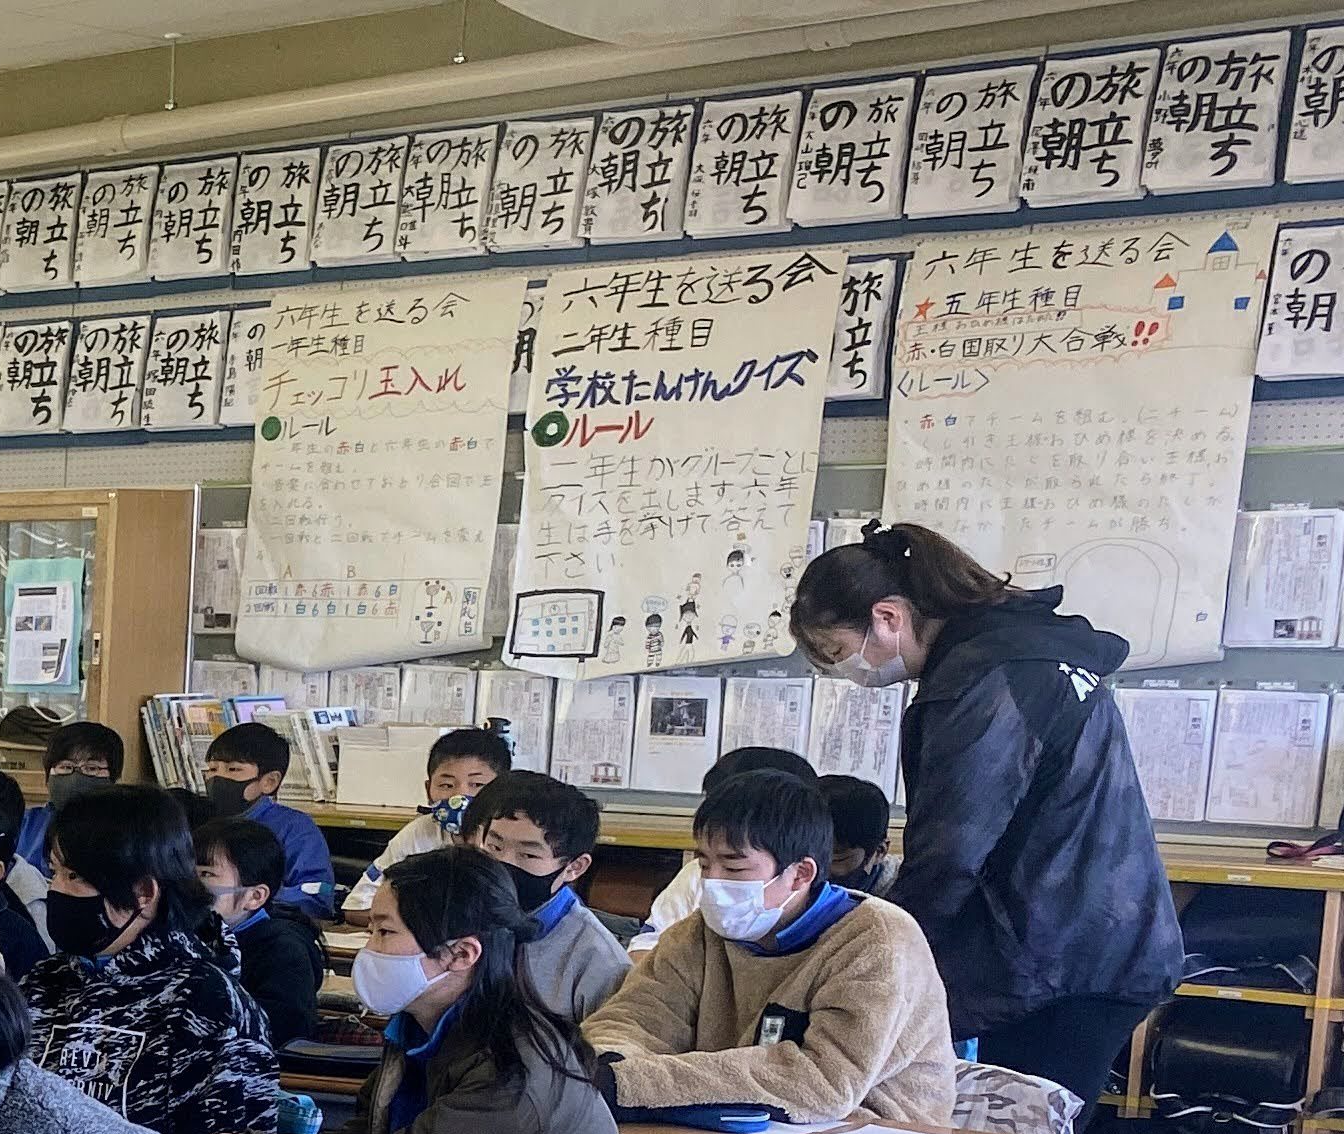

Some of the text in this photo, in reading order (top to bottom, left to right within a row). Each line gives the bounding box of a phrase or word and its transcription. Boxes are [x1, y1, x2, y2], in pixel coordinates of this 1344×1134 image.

[1164, 46, 1185, 77] 六年
[1164, 54, 1219, 134] の朝
[710, 111, 749, 187] の朝
[808, 99, 858, 186] の朝
[853, 95, 904, 204] 旅立ち
[922, 91, 969, 171] の朝
[967, 79, 1021, 199] 旅立ち
[1035, 71, 1092, 171] の朝
[1081, 60, 1151, 188] 旅立ち
[1209, 49, 1282, 177] 旅立ち
[322, 150, 364, 220] の朝
[412, 138, 453, 223] の朝
[448, 136, 493, 244] 旅立ち
[497, 133, 540, 231] の朝
[539, 128, 589, 236] 旅立ち
[598, 115, 645, 195] の朝
[740, 103, 793, 226] 旅立ち
[14, 187, 45, 248] の朝
[41, 182, 78, 280] 旅立ち
[85, 183, 116, 240] の朝
[112, 174, 149, 261] 旅立ち
[160, 181, 194, 243] の朝
[192, 166, 230, 264] 旅立ち
[238, 165, 273, 236] の朝
[273, 160, 312, 264] 旅立ち
[359, 142, 405, 253] 旅立ち
[562, 252, 838, 313] 六年生を送る会
[924, 231, 1191, 280] 六年生を送る会
[1283, 248, 1338, 333] の朝
[273, 291, 471, 330] 六年生を送る会
[552, 316, 714, 358] 二年生種目
[841, 270, 885, 390] 旅立ち
[937, 284, 1082, 318] 五年生種目
[7, 329, 38, 392] の朝
[29, 325, 68, 427] 旅立ち
[75, 327, 110, 392] の朝
[108, 322, 146, 427] 旅立ち
[157, 328, 189, 386] の朝
[185, 323, 220, 421] 旅立ち
[243, 322, 267, 372] の朝
[271, 334, 365, 358] 一年生種目
[545, 348, 819, 409] 学校たんけんクイズ
[263, 363, 467, 410] チェッコリ玉入れ
[281, 415, 338, 441] ルール
[563, 410, 655, 448] ルール
[283, 565, 357, 579] A B
